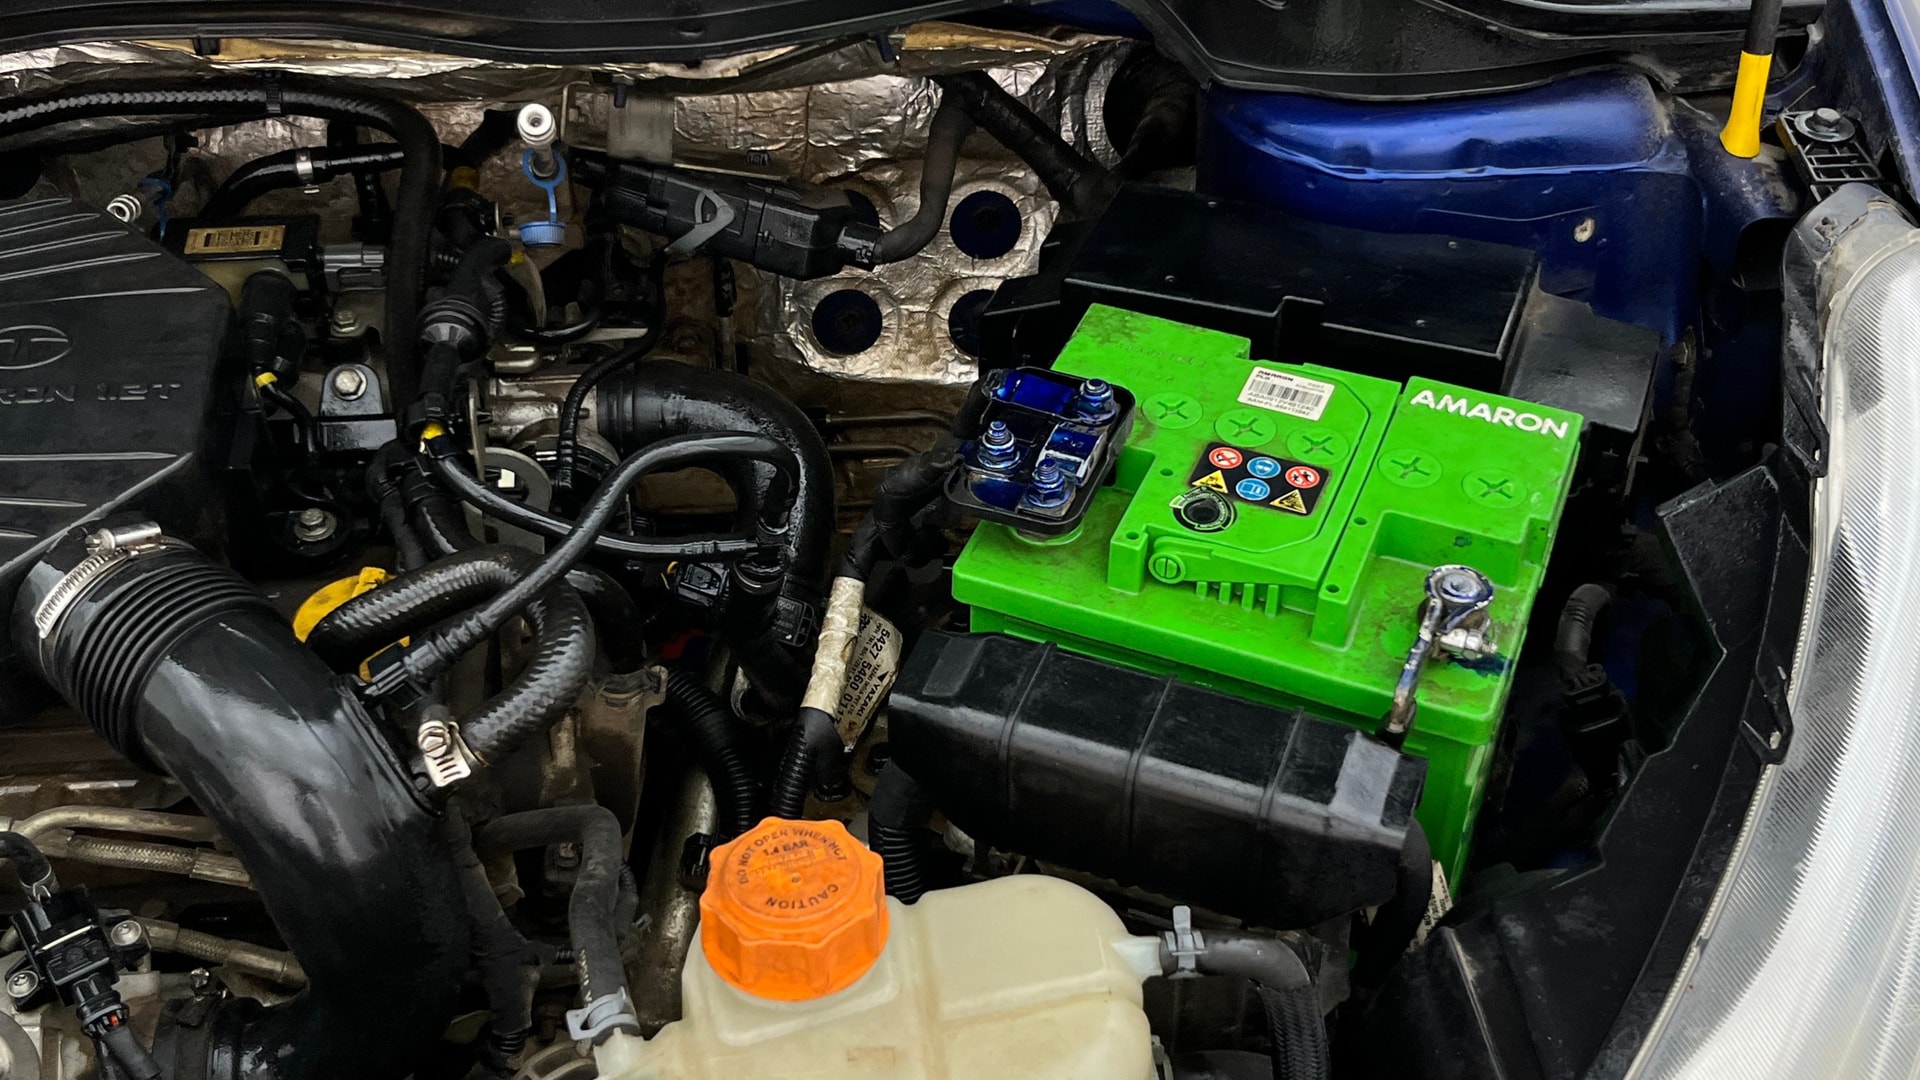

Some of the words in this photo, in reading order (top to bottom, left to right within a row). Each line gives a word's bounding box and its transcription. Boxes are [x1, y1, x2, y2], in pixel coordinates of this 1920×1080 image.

[1410, 390, 1569, 438] AMARON
[869, 628, 891, 660] 5427
[848, 660, 873, 691] 5460
[856, 682, 881, 718] YAZAKI
[754, 829, 788, 847] OPEN
[763, 846, 780, 857] 1.4
[783, 840, 809, 853] BAR
[792, 828, 828, 845] WHEN
[738, 846, 756, 867] NOT
[737, 869, 749, 884] DO
[765, 883, 839, 910] CAUTION
